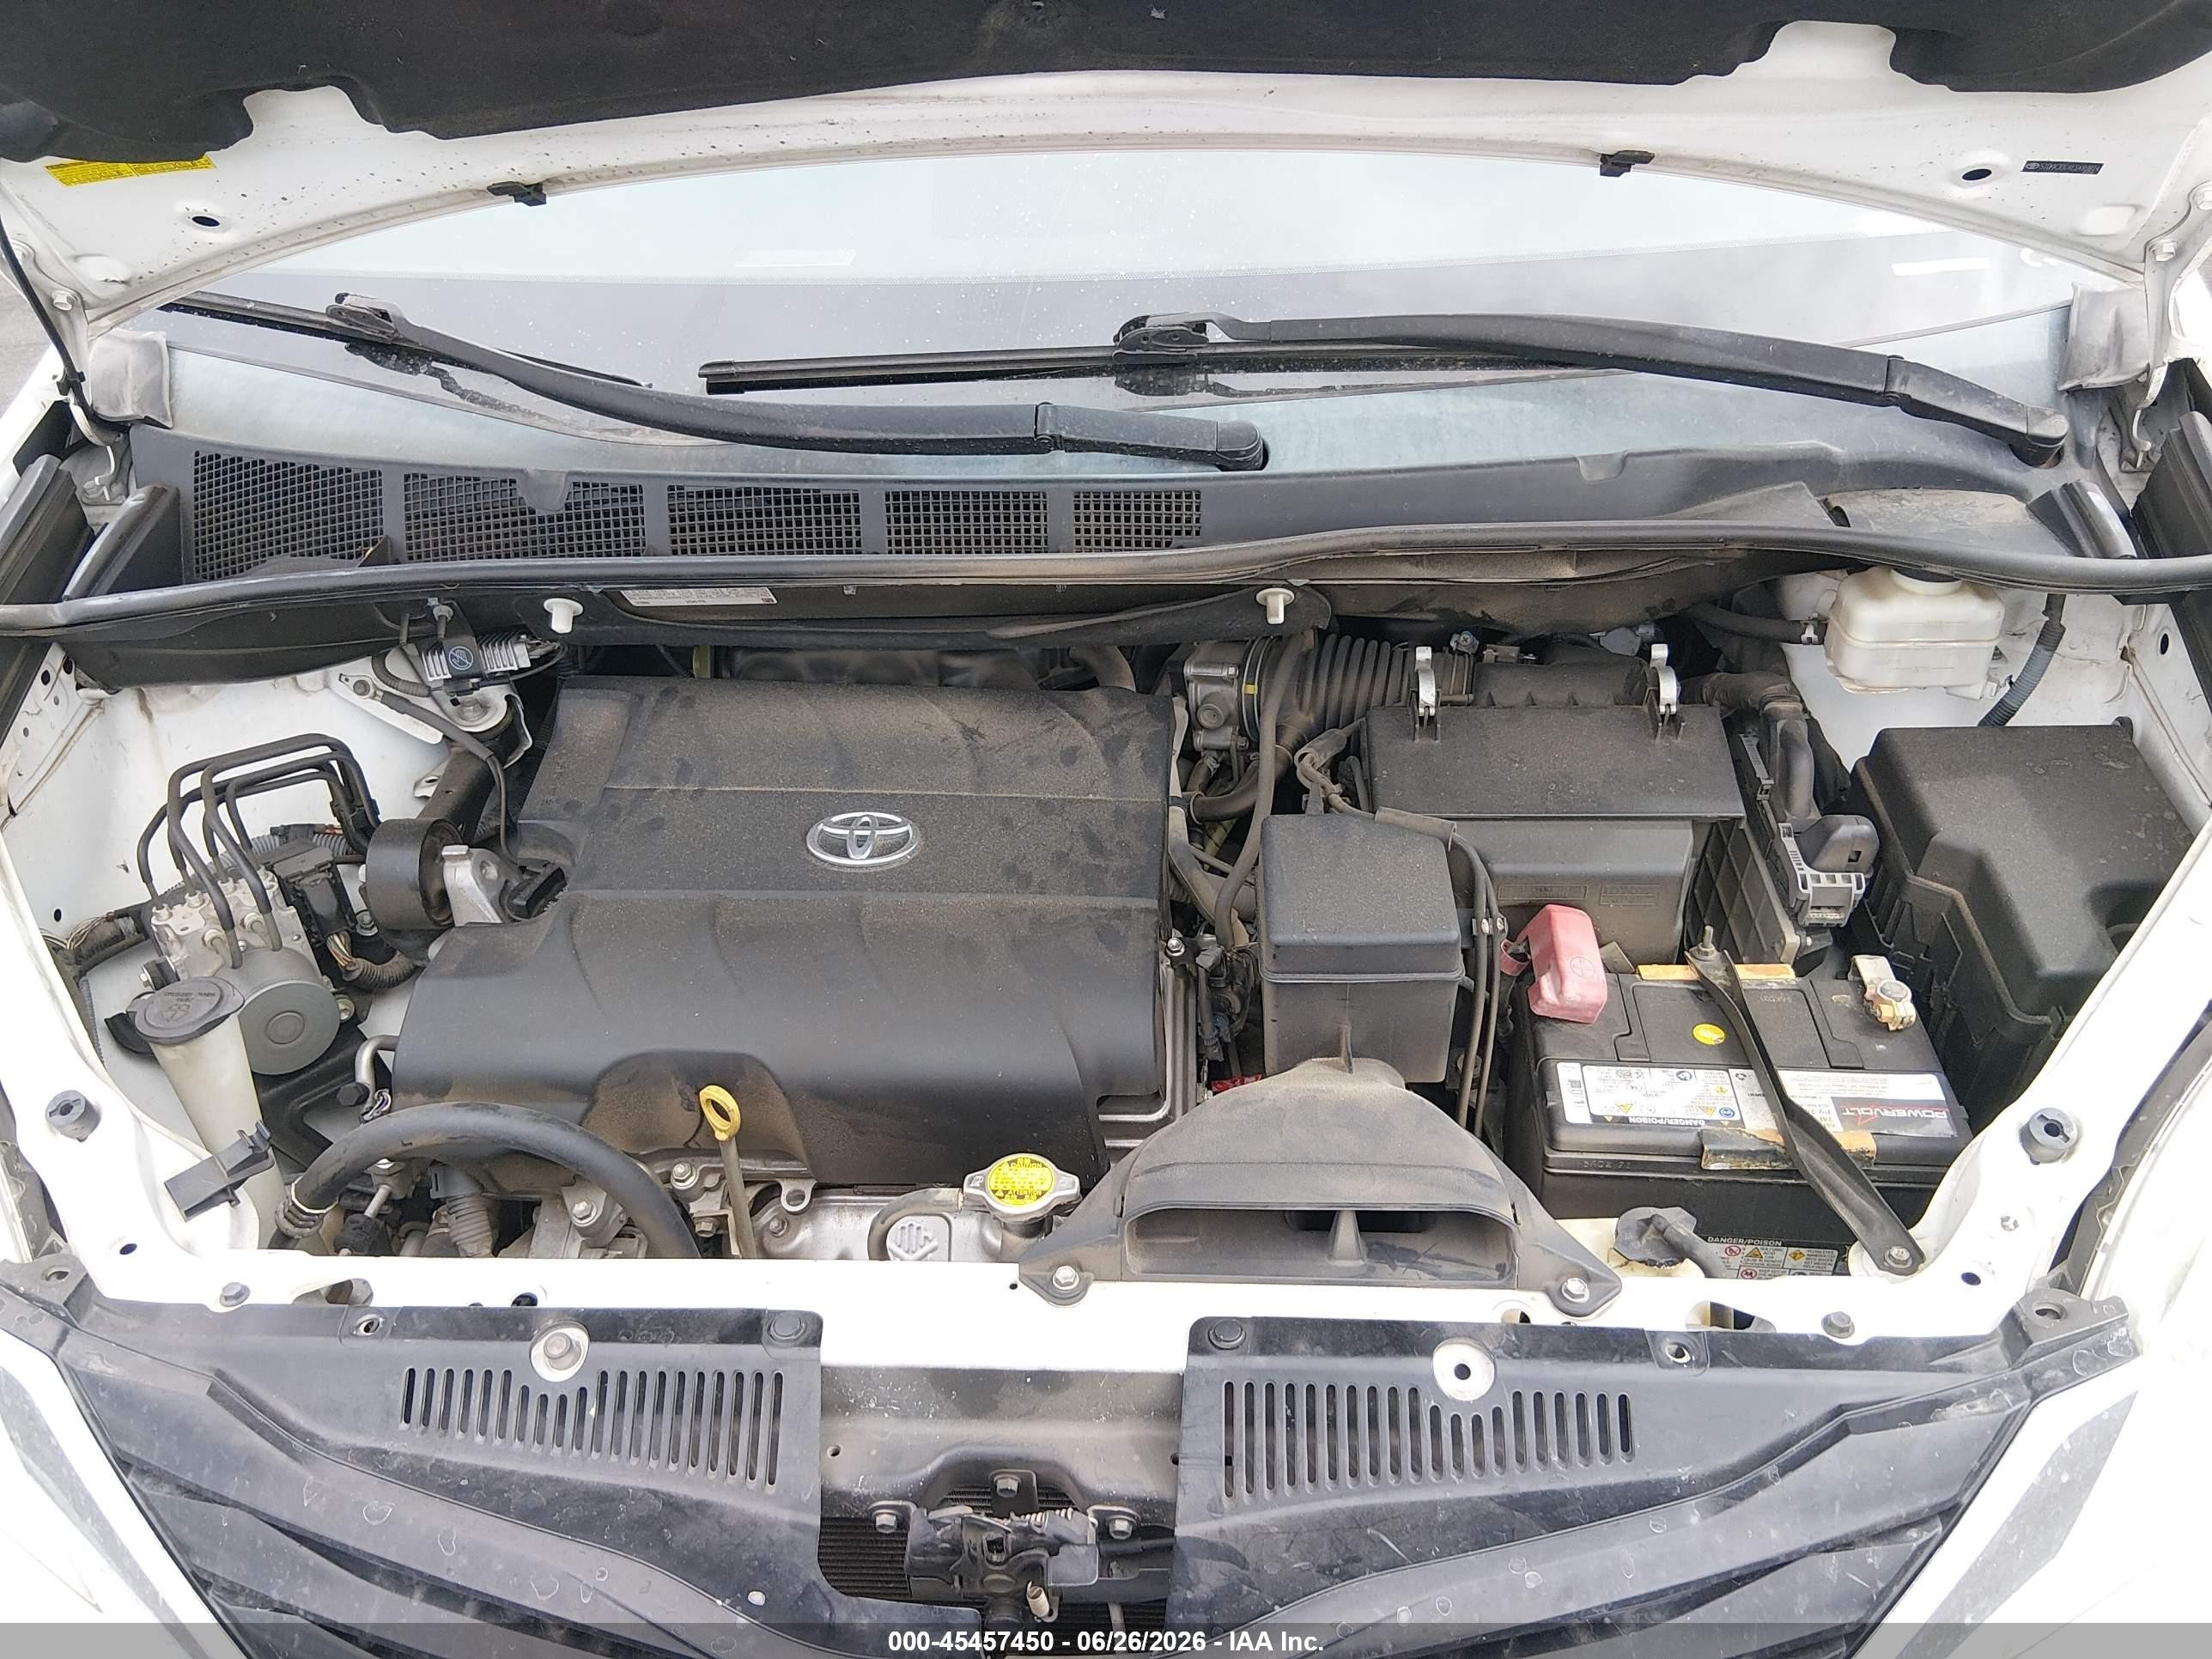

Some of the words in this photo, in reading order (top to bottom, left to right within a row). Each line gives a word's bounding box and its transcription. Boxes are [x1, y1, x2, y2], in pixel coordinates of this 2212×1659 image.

[1842, 1108, 1948, 1119] POWERVOLT
[1629, 1116, 1705, 1126] DANGER/POISON
[1707, 1237, 1783, 1246] DANGER/POISON
